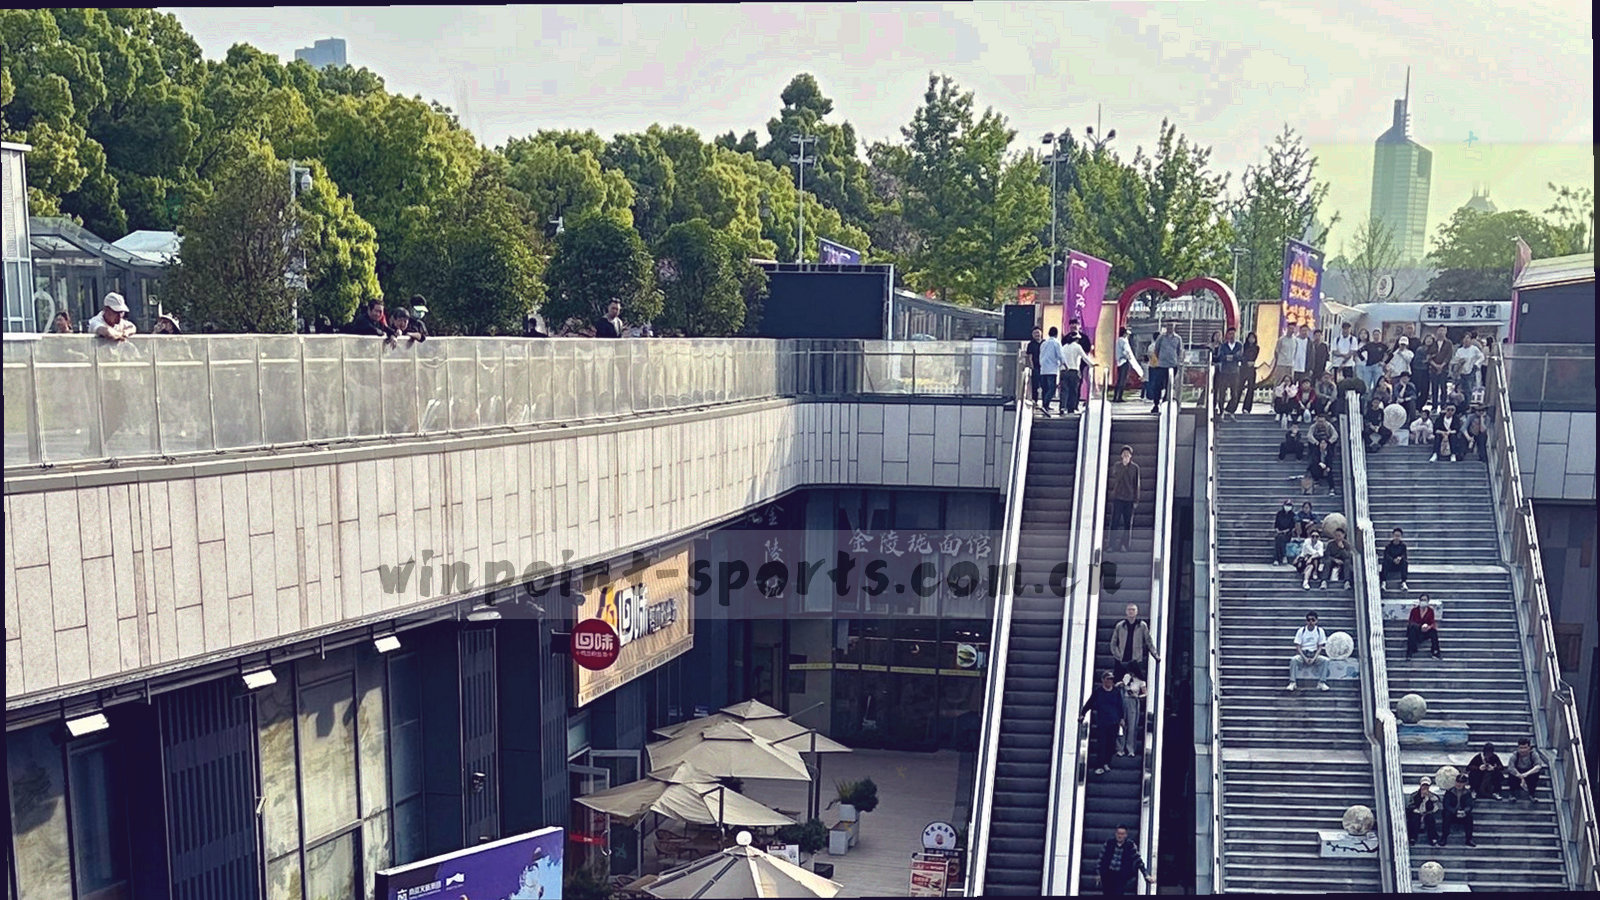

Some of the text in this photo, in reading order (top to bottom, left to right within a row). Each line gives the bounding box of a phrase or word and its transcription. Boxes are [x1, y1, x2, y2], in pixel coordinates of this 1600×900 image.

[1427, 305, 1497, 319] 奇福 汉堡
[575, 632, 614, 651] 回味
